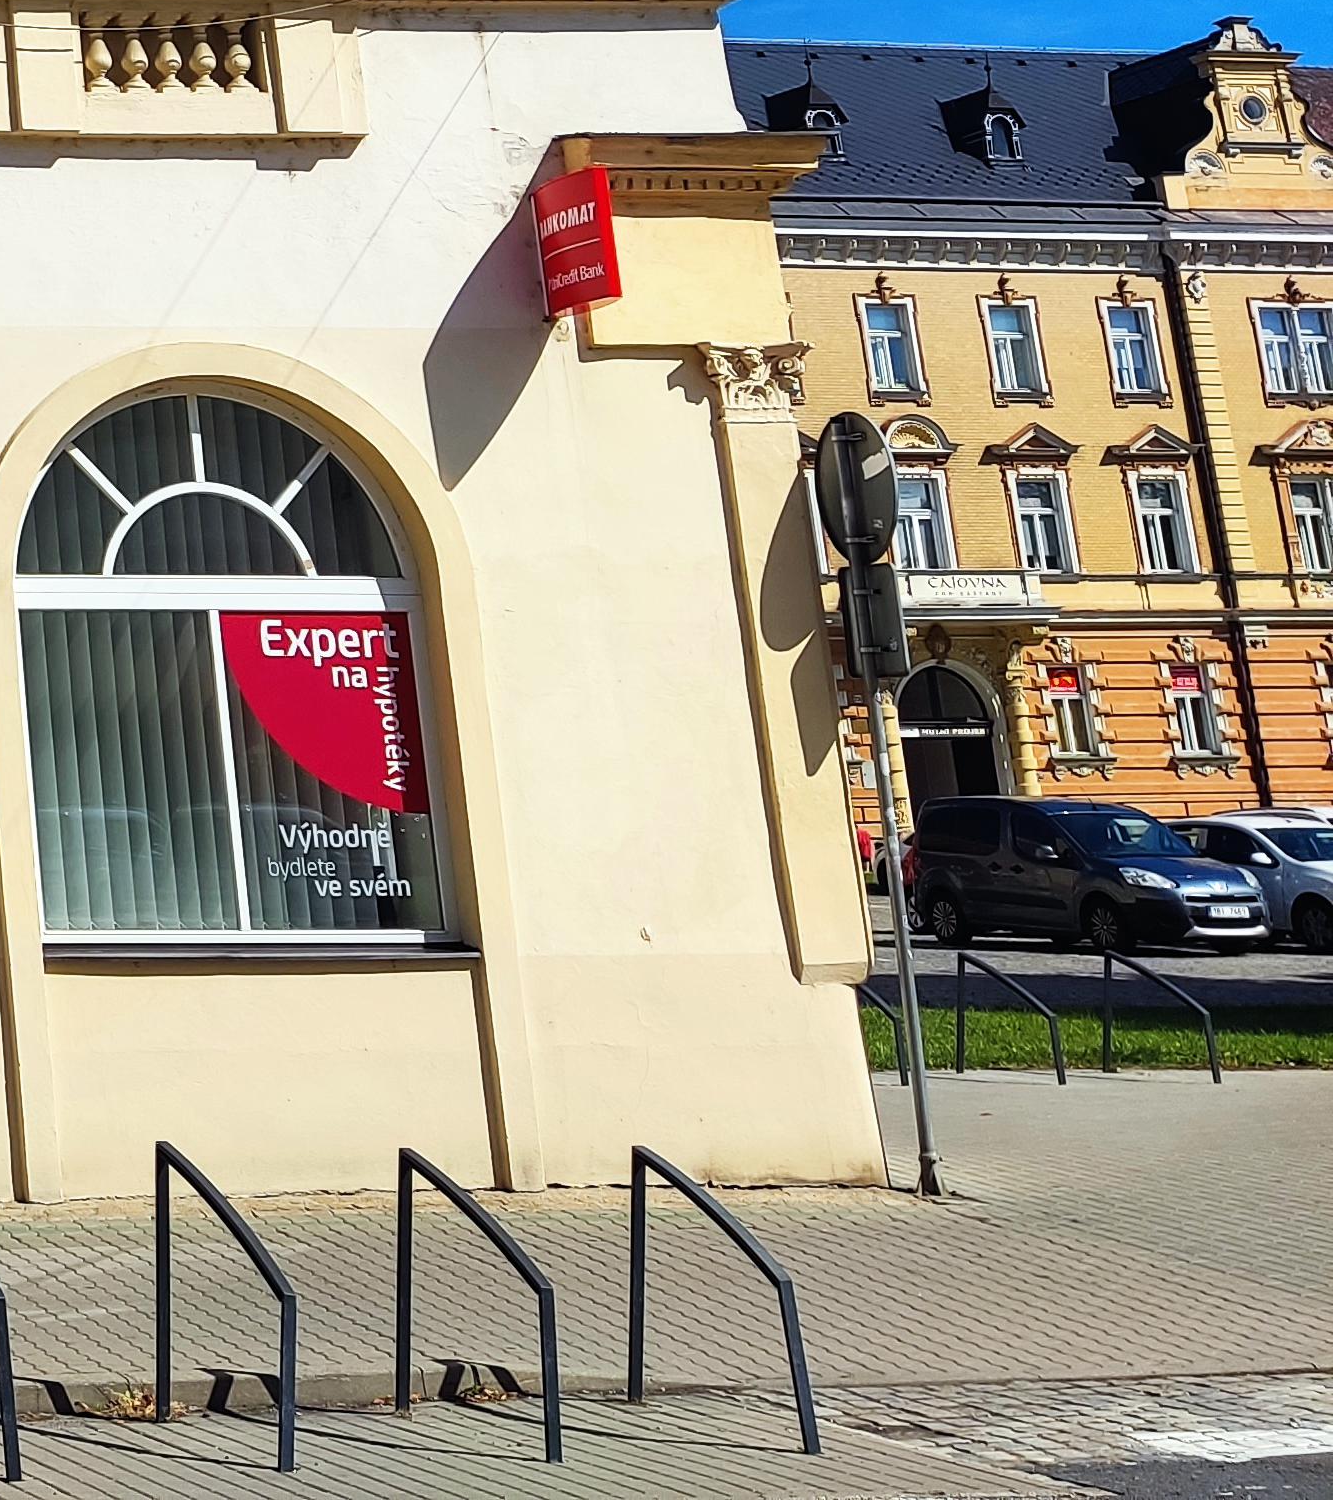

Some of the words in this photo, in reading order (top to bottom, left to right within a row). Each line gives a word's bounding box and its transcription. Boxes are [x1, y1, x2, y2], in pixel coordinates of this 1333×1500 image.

[580, 261, 605, 281] Bank
[259, 619, 399, 667] Expert
[332, 664, 368, 689] na
[372, 666, 411, 792] hypotéky
[278, 822, 392, 853] Výhodně
[267, 856, 336, 882] bydlete
[315, 878, 342, 898] ve
[348, 873, 412, 898] svém
